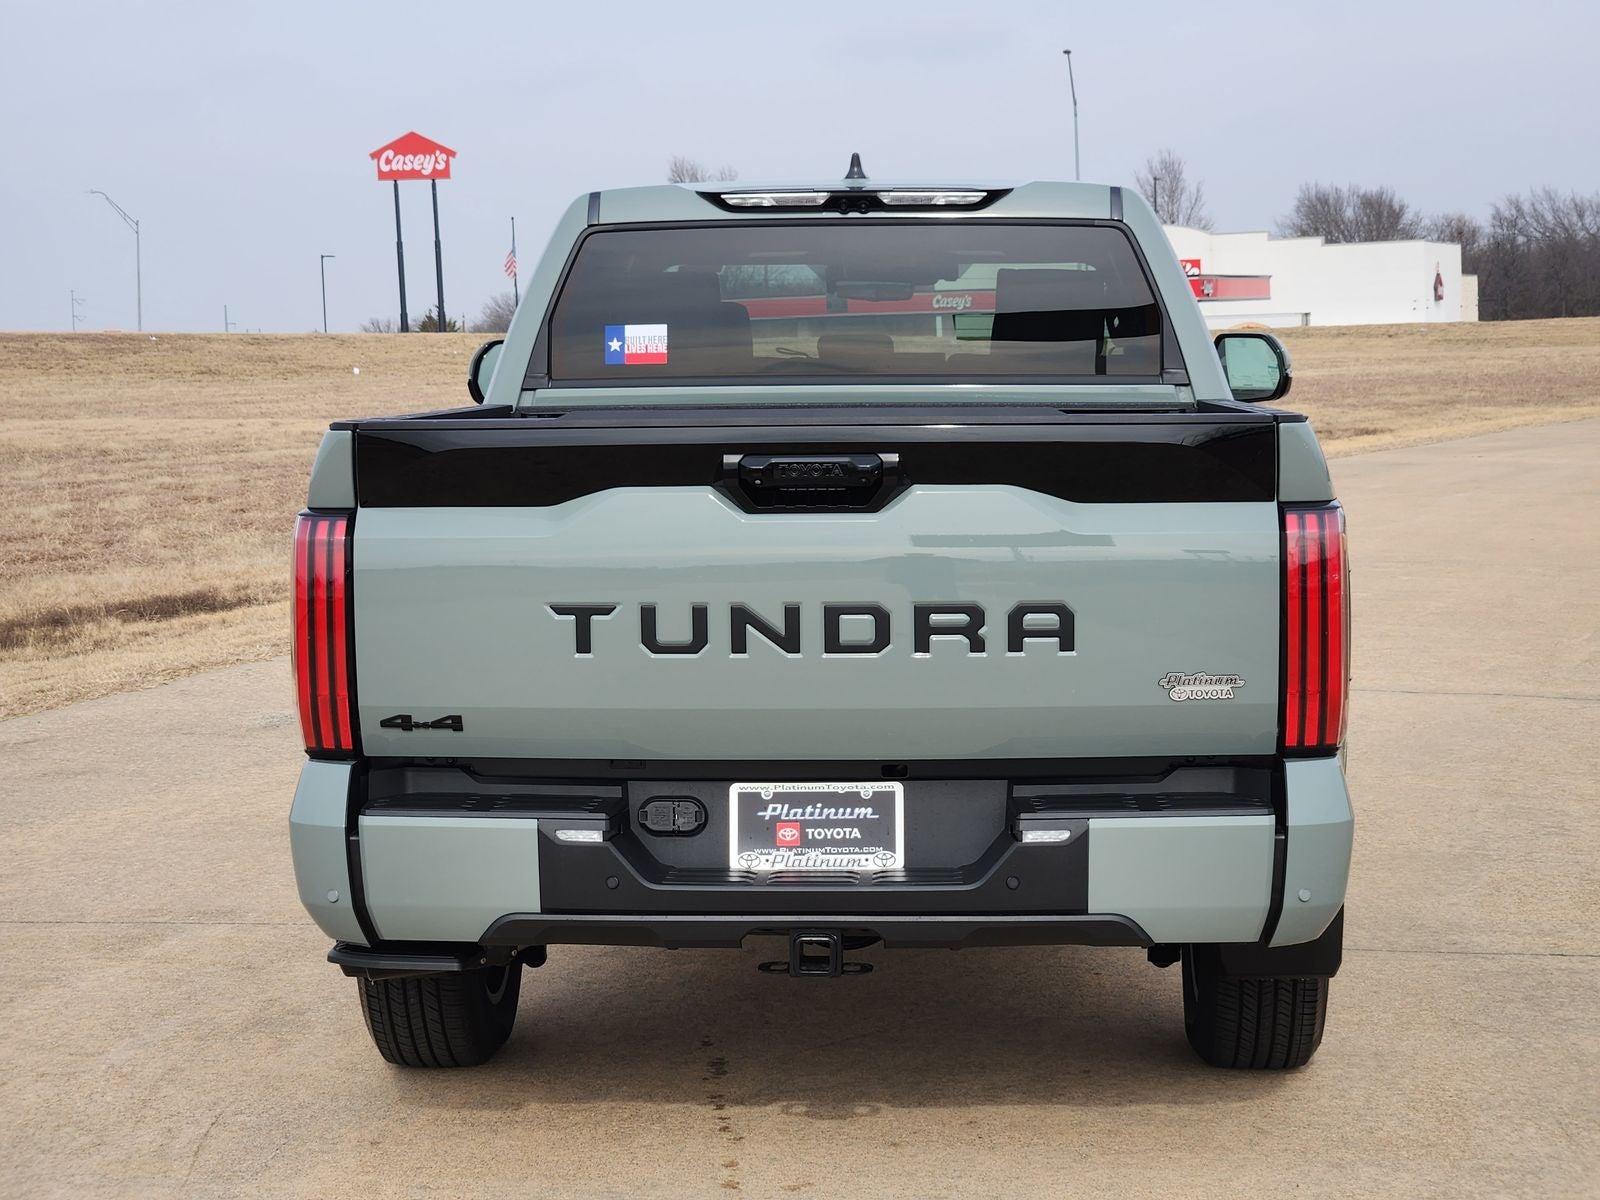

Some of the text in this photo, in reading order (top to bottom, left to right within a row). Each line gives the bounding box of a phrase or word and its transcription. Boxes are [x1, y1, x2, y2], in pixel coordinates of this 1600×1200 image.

[380, 149, 447, 175] Casey's
[933, 294, 972, 309] Casey's
[625, 335, 667, 344] BUILT HERE
[625, 344, 667, 353] LIVES HERE
[778, 463, 844, 477] TOYOTA
[546, 601, 1077, 658] TUNDRA
[1159, 672, 1245, 688] Platinum
[1189, 688, 1232, 698] TOYOTA
[738, 783, 895, 792] www.PlatinumToyota.com
[757, 803, 880, 820] Platinum
[805, 827, 862, 839] TOYOTA
[769, 852, 869, 868] Platinum
